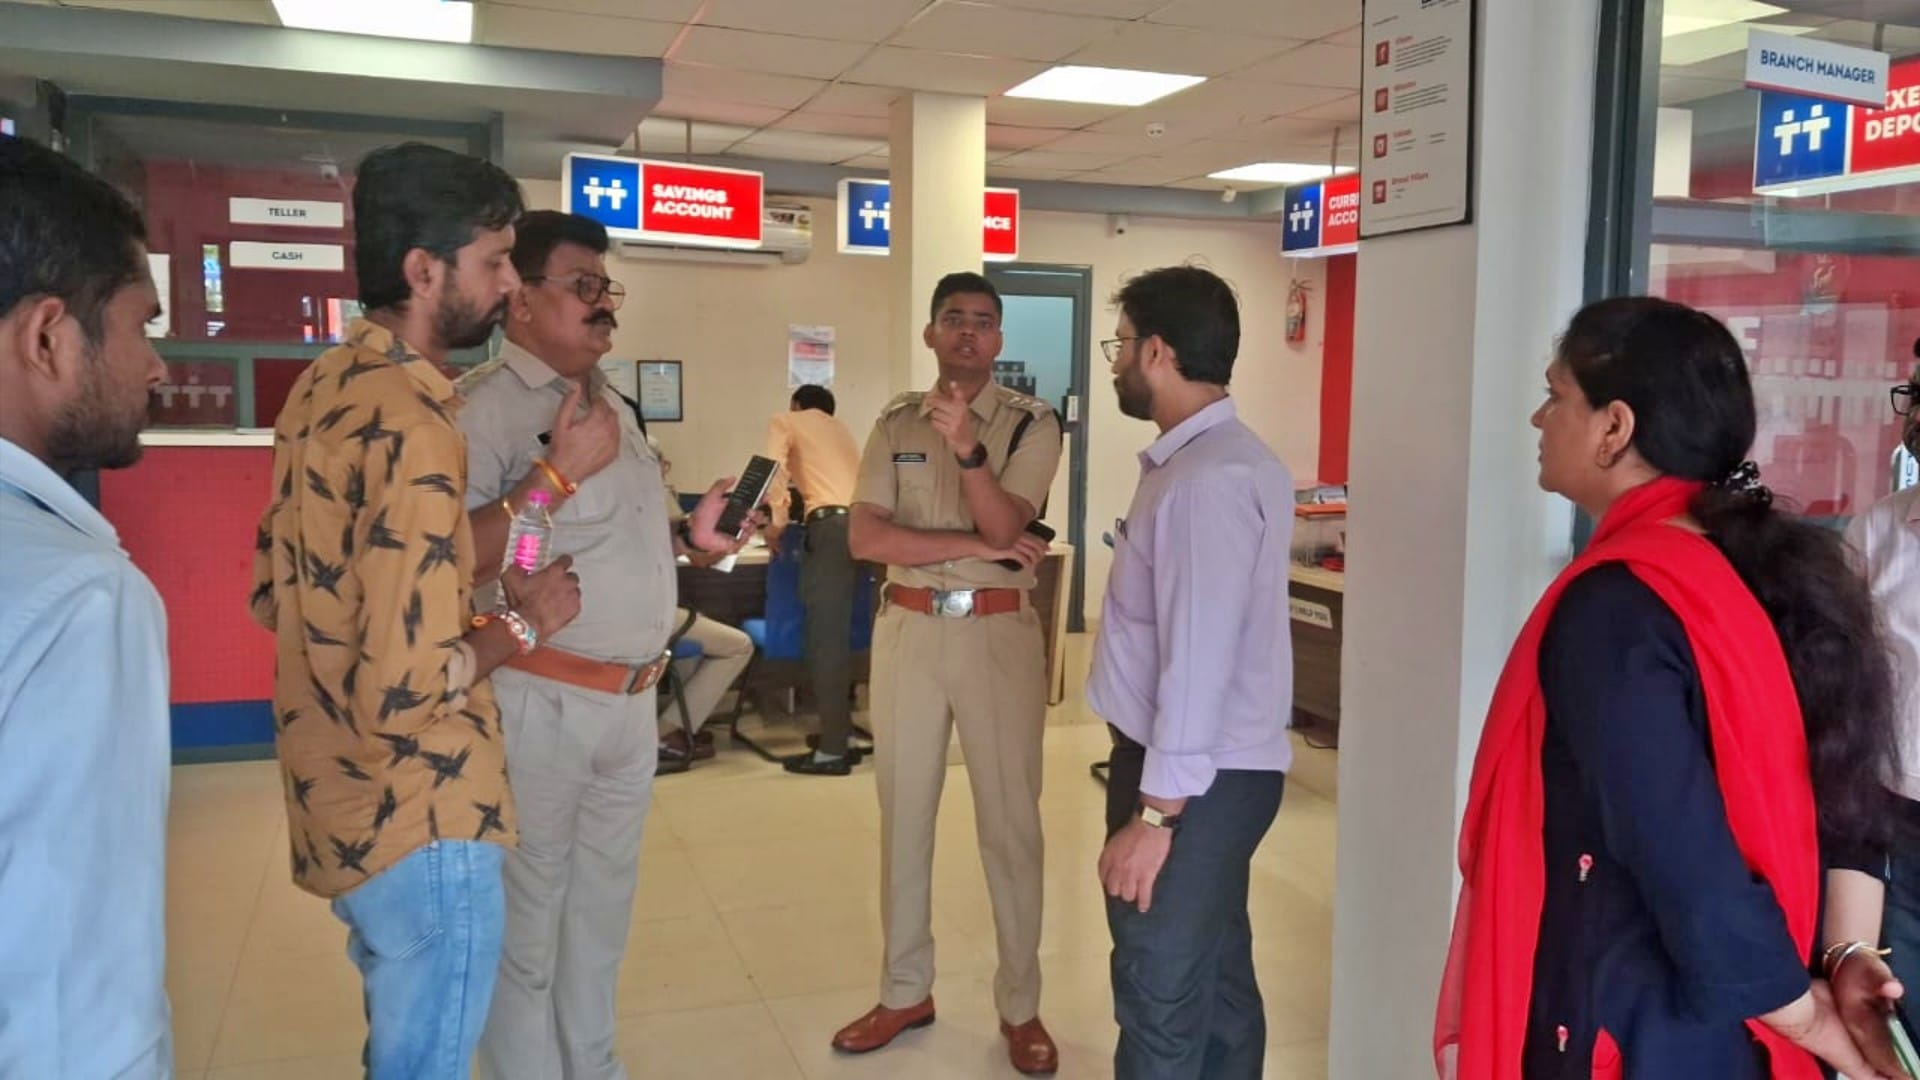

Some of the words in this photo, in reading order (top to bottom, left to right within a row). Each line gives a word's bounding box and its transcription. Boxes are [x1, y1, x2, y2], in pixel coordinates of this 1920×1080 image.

[1760, 49, 1814, 73] BRANCH
[1816, 61, 1876, 84] MANAGER
[652, 183, 728, 204] SAVINGS
[268, 207, 307, 217] TELLER
[652, 201, 734, 221] ACCOUNT
[271, 251, 303, 261] CASH
